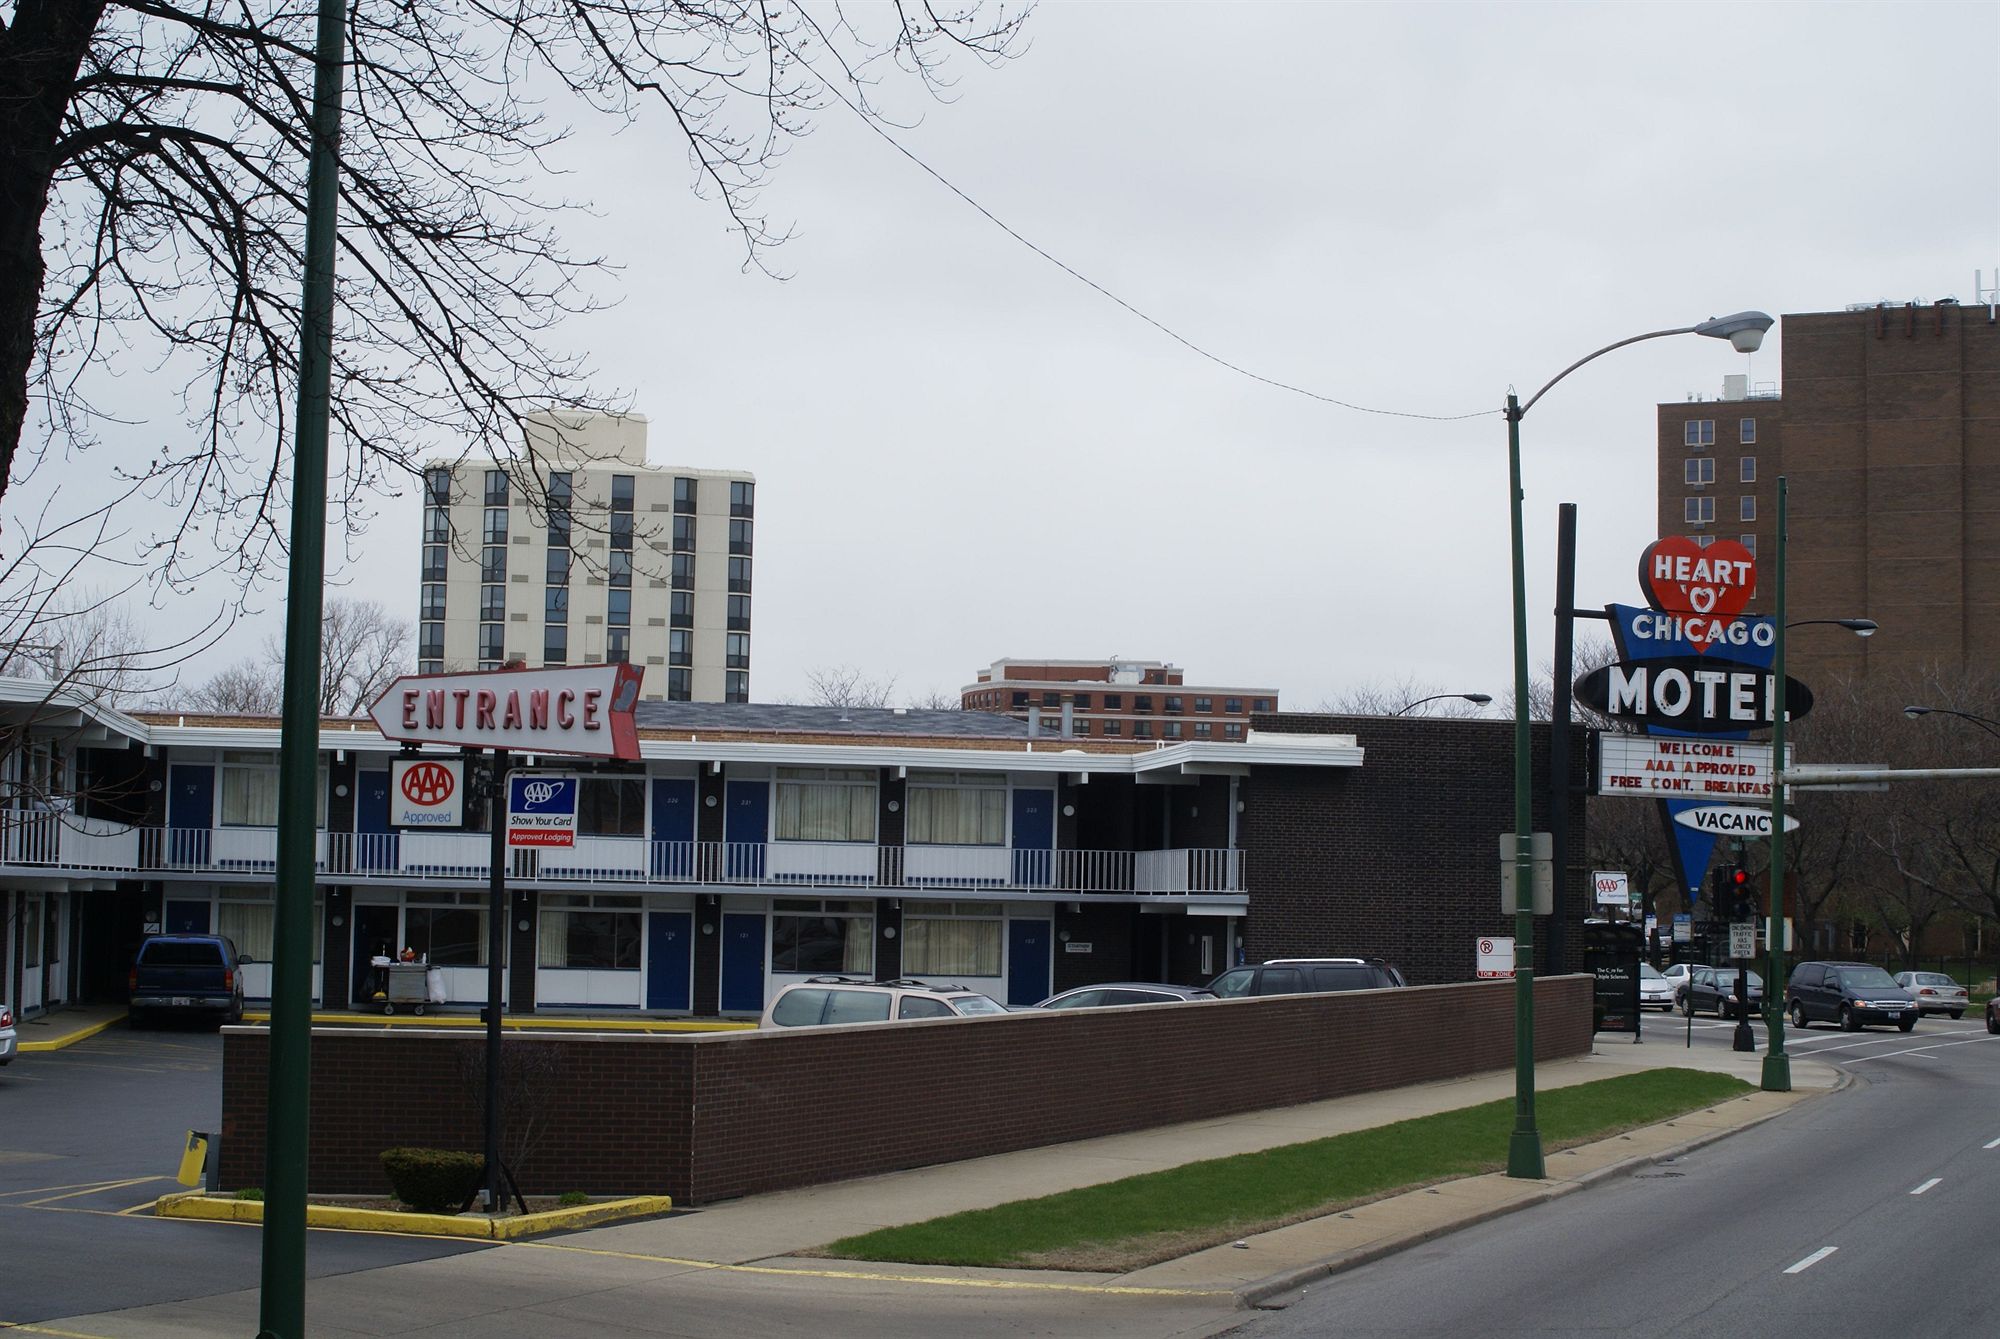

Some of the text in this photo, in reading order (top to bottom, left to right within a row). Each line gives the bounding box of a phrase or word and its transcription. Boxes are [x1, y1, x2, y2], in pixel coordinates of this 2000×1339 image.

[1655, 555, 1751, 586] HEART
[1632, 614, 1776, 647] CHICAGO
[402, 688, 602, 730] ENTRANCE
[1660, 742, 1734, 758] WELCOME
[1645, 759, 1675, 772] AAA
[403, 762, 453, 806] AAA
[525, 782, 552, 803] AAA
[1610, 776, 1772, 795] FREE CONT. BREAKFAS
[403, 810, 452, 824] Approved
[511, 815, 573, 826] Show Your Card
[511, 832, 572, 843] Approved Lodging
